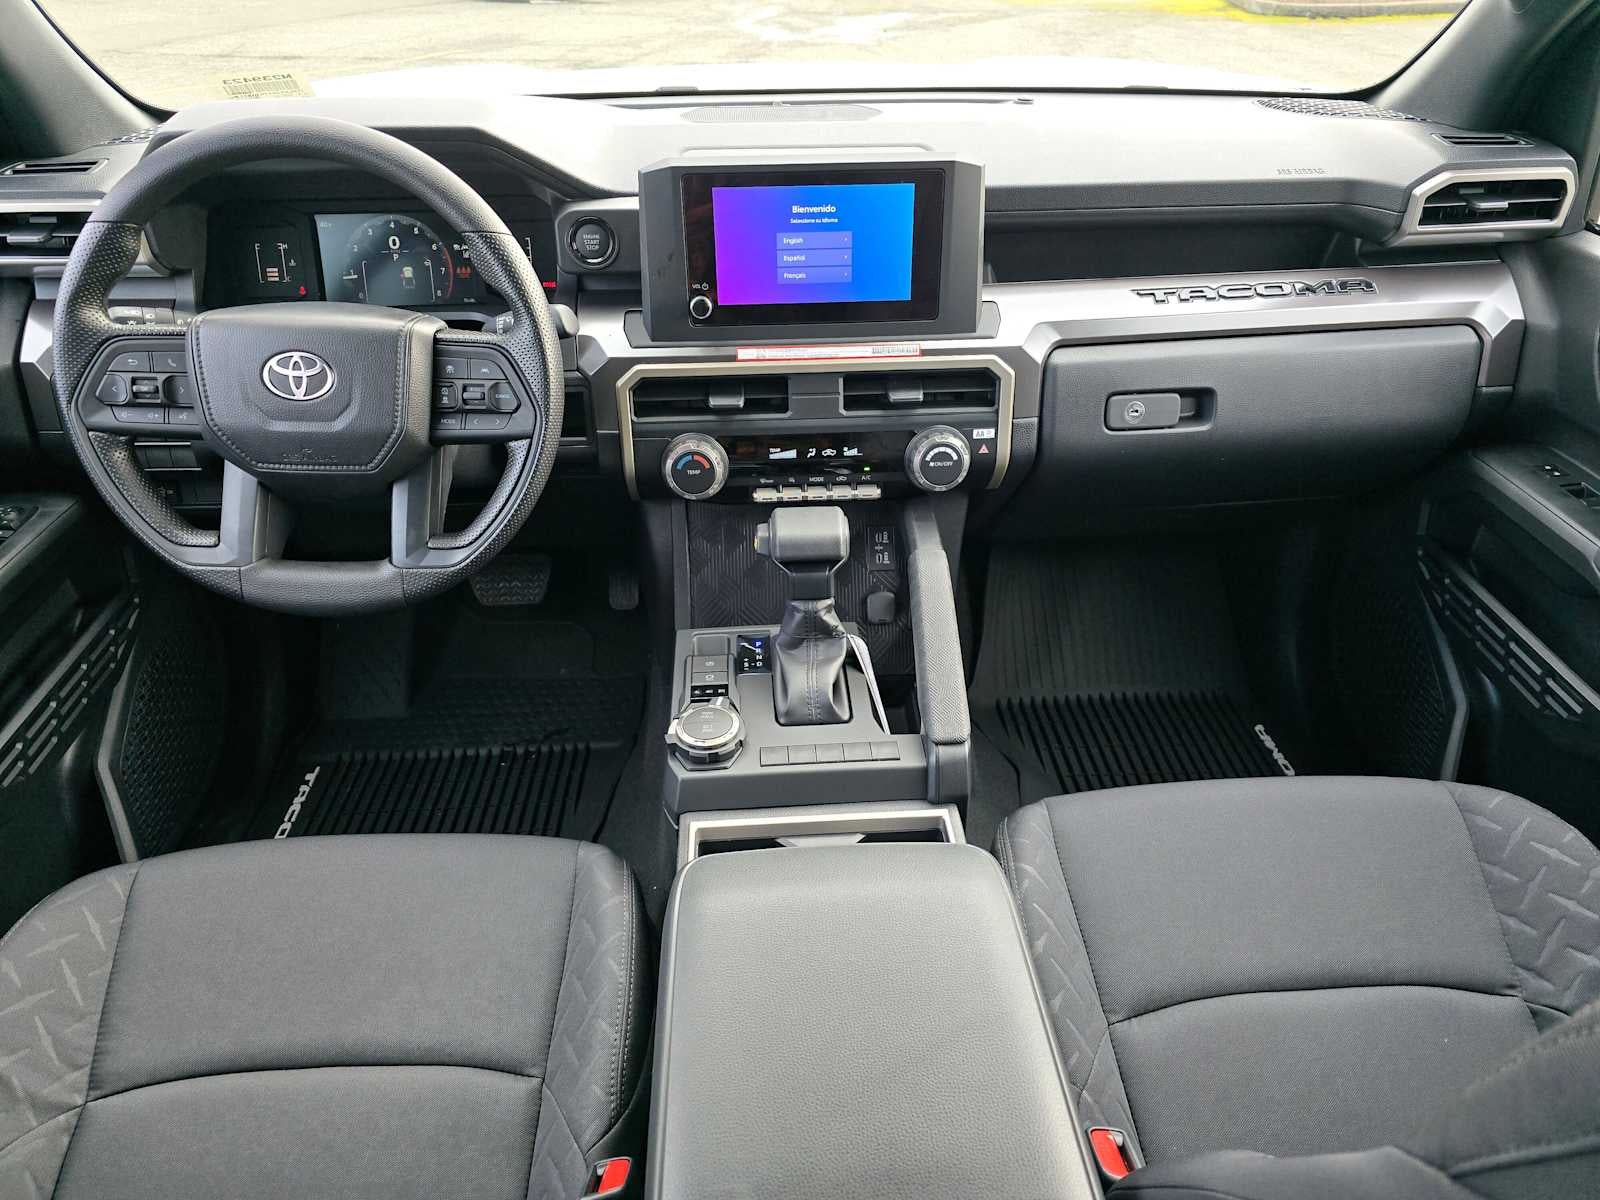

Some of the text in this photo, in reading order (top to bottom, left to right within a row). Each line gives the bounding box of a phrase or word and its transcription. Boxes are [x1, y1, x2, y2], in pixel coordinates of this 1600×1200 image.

[792, 204, 837, 214] Bienvenido
[389, 221, 395, 229] 4
[367, 228, 373, 236] 3
[388, 235, 401, 249] 0
[783, 237, 804, 245] English
[392, 253, 399, 261] P
[783, 255, 806, 263] Español
[783, 272, 807, 281] Français
[1130, 278, 1377, 305] TACOMA
